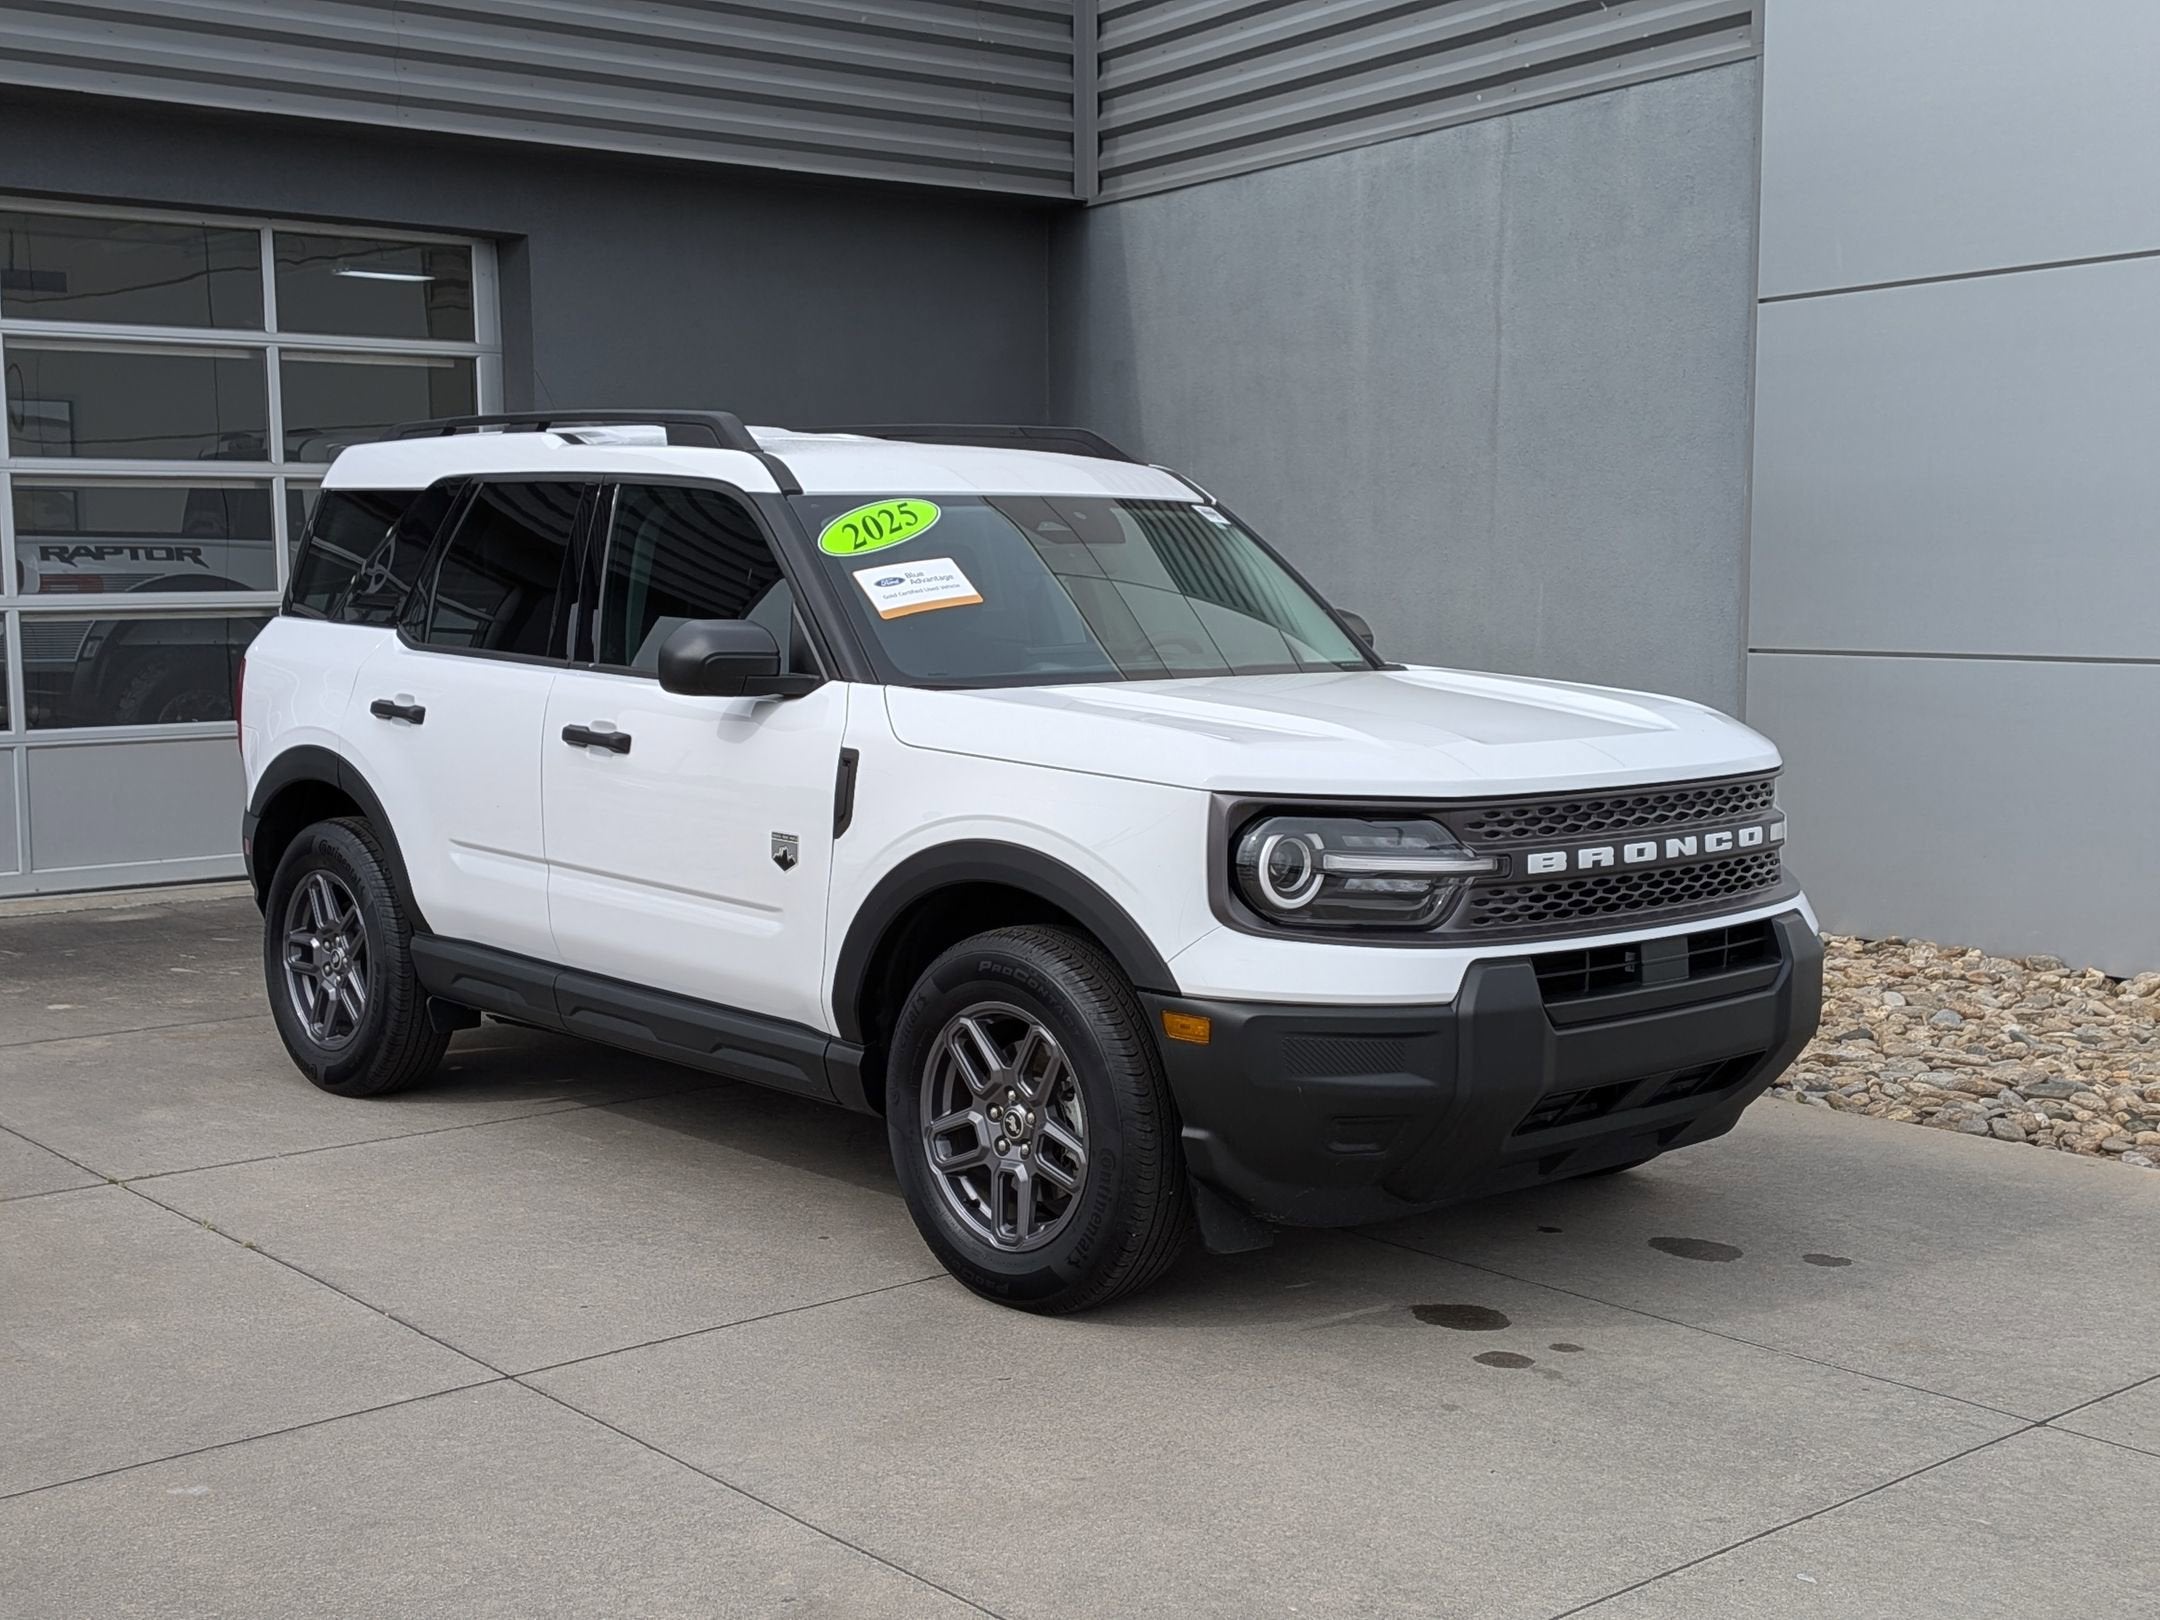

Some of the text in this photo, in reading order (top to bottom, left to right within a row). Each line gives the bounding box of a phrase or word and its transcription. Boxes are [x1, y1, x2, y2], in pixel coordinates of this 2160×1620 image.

[841, 502, 919, 550] 2025
[38, 545, 210, 569] RAPTOR
[904, 571, 925, 579] Blue
[910, 574, 955, 585] Advantage
[1527, 826, 1763, 875] BRONCO
[1072, 1147, 1116, 1261] Continental
